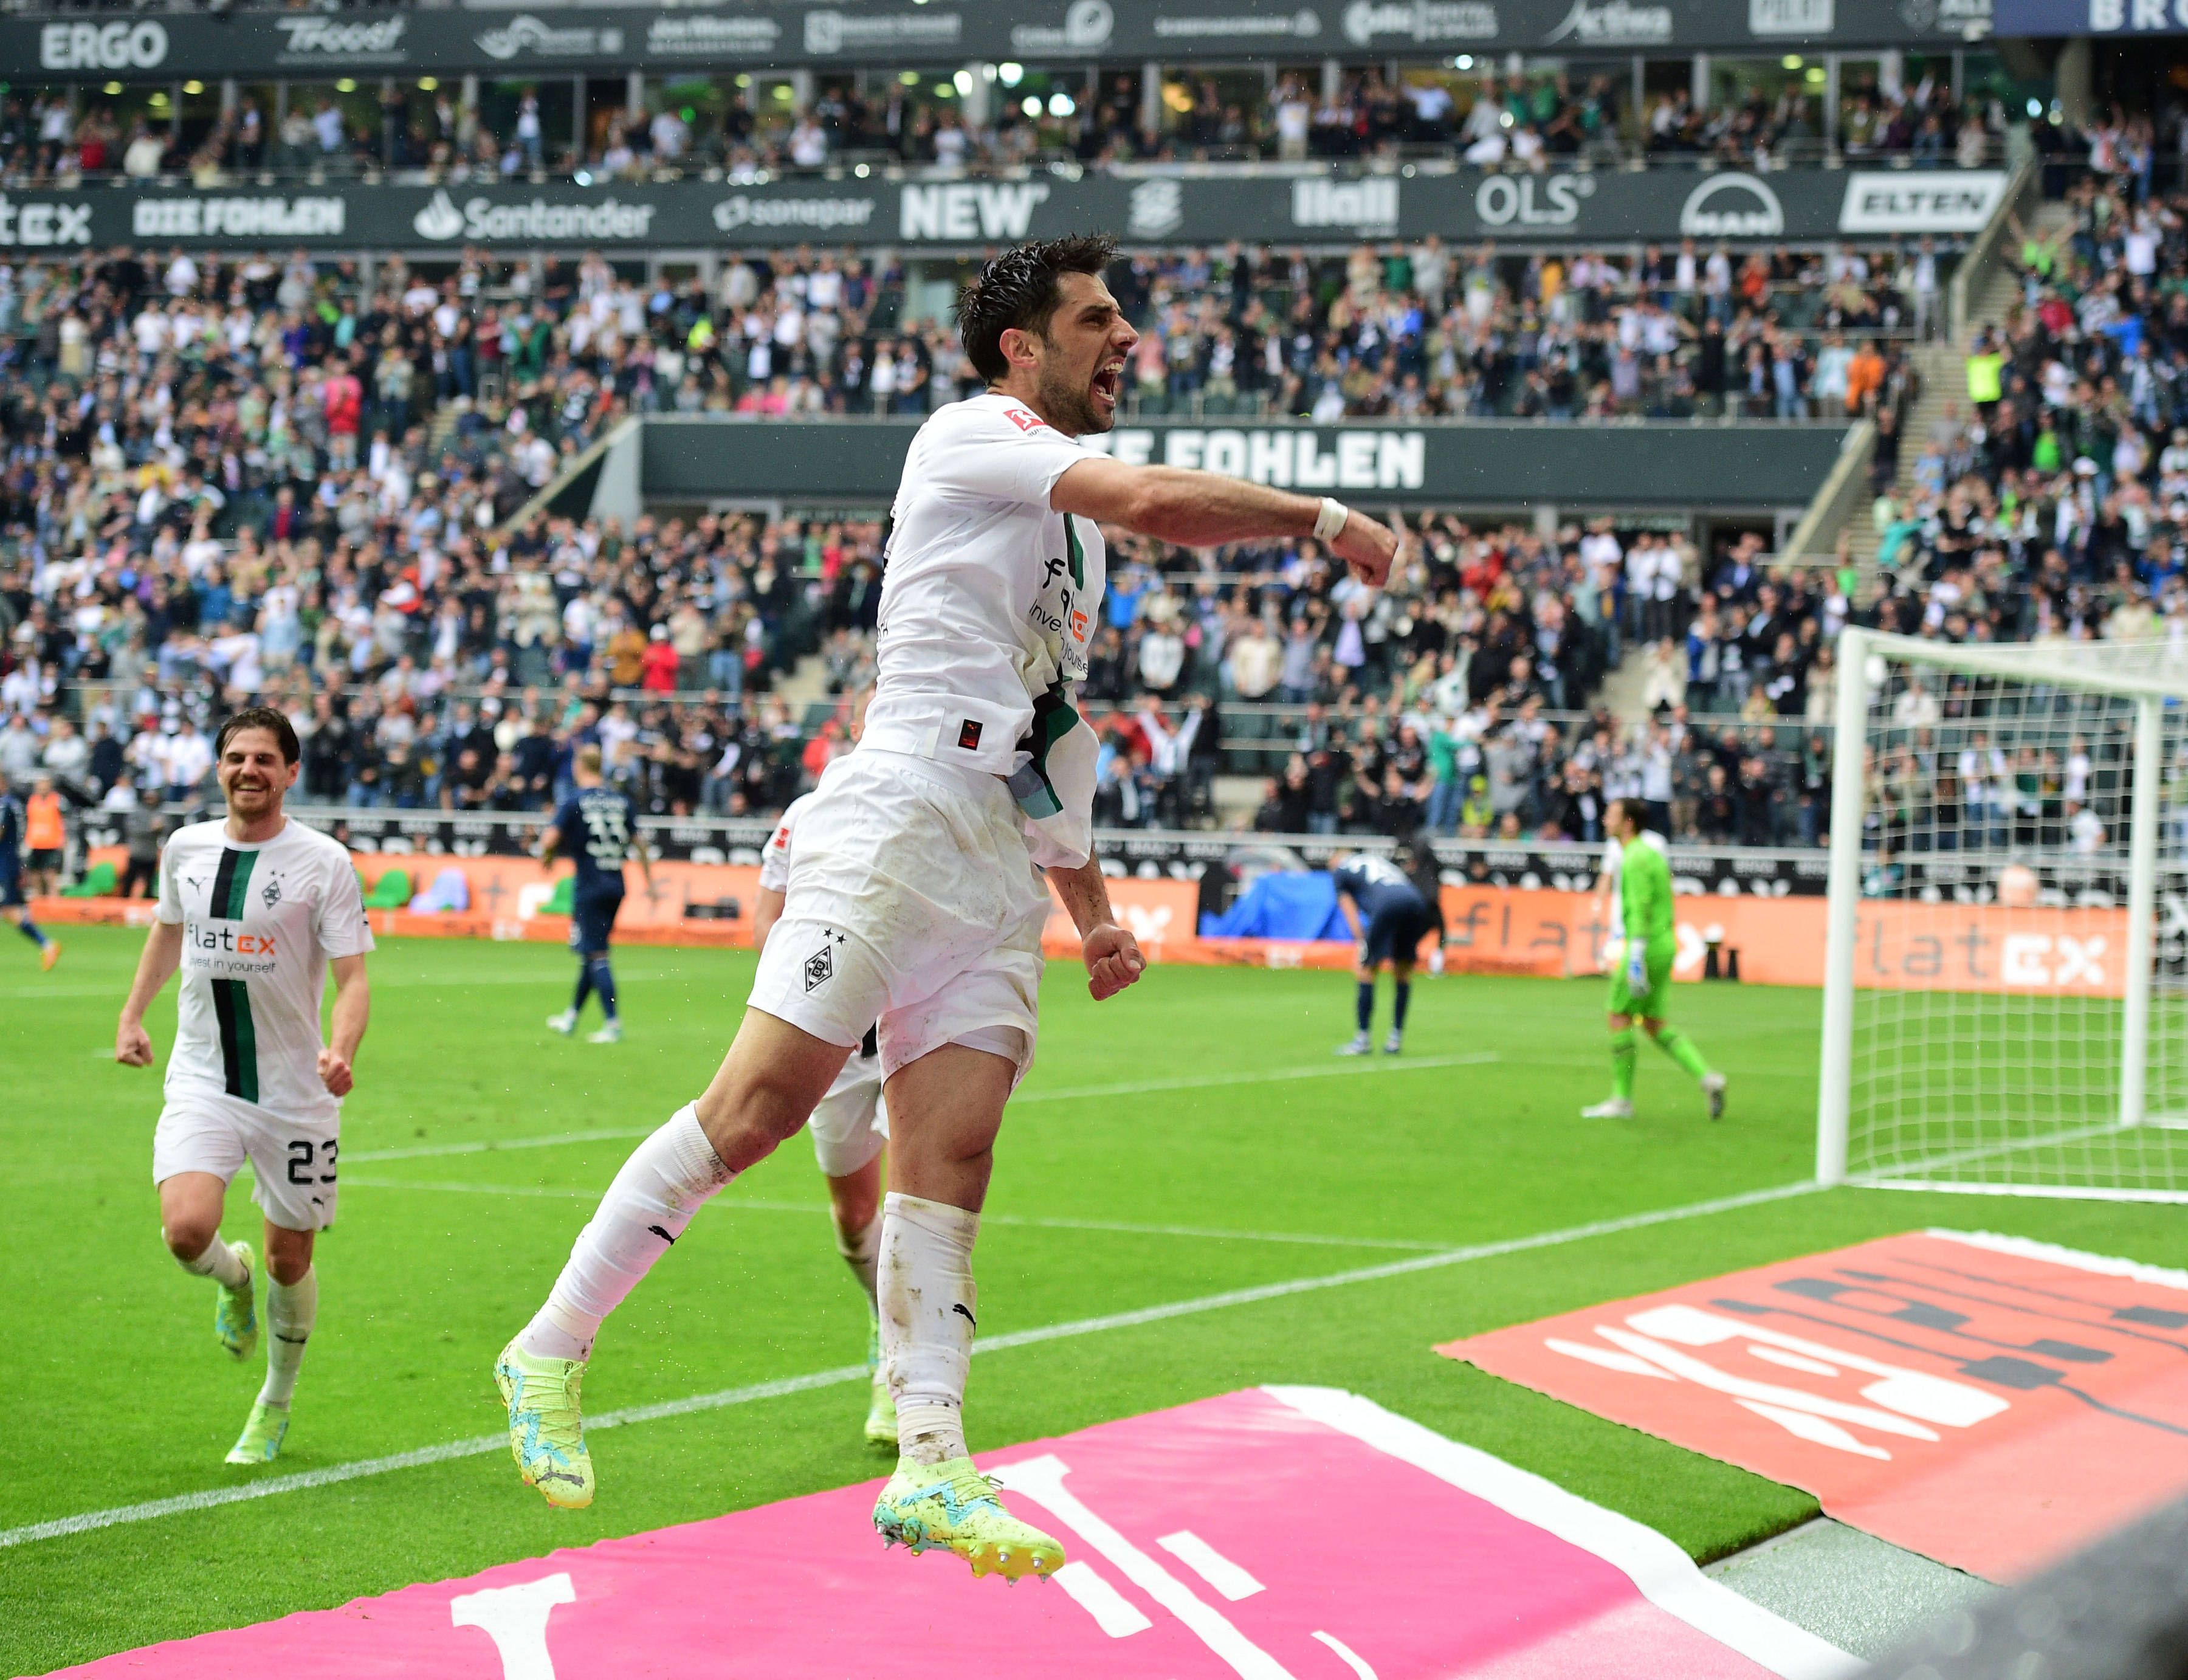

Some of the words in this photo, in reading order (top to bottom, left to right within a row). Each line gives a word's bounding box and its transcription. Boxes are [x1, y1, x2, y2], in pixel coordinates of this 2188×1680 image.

[41, 20, 168, 69] ERGO
[204, 196, 345, 236] FOHLEN
[463, 196, 656, 239] Santander
[1862, 191, 1986, 214] ELTEN
[227, 960, 277, 974] yourself
[287, 1140, 339, 1186] 23
